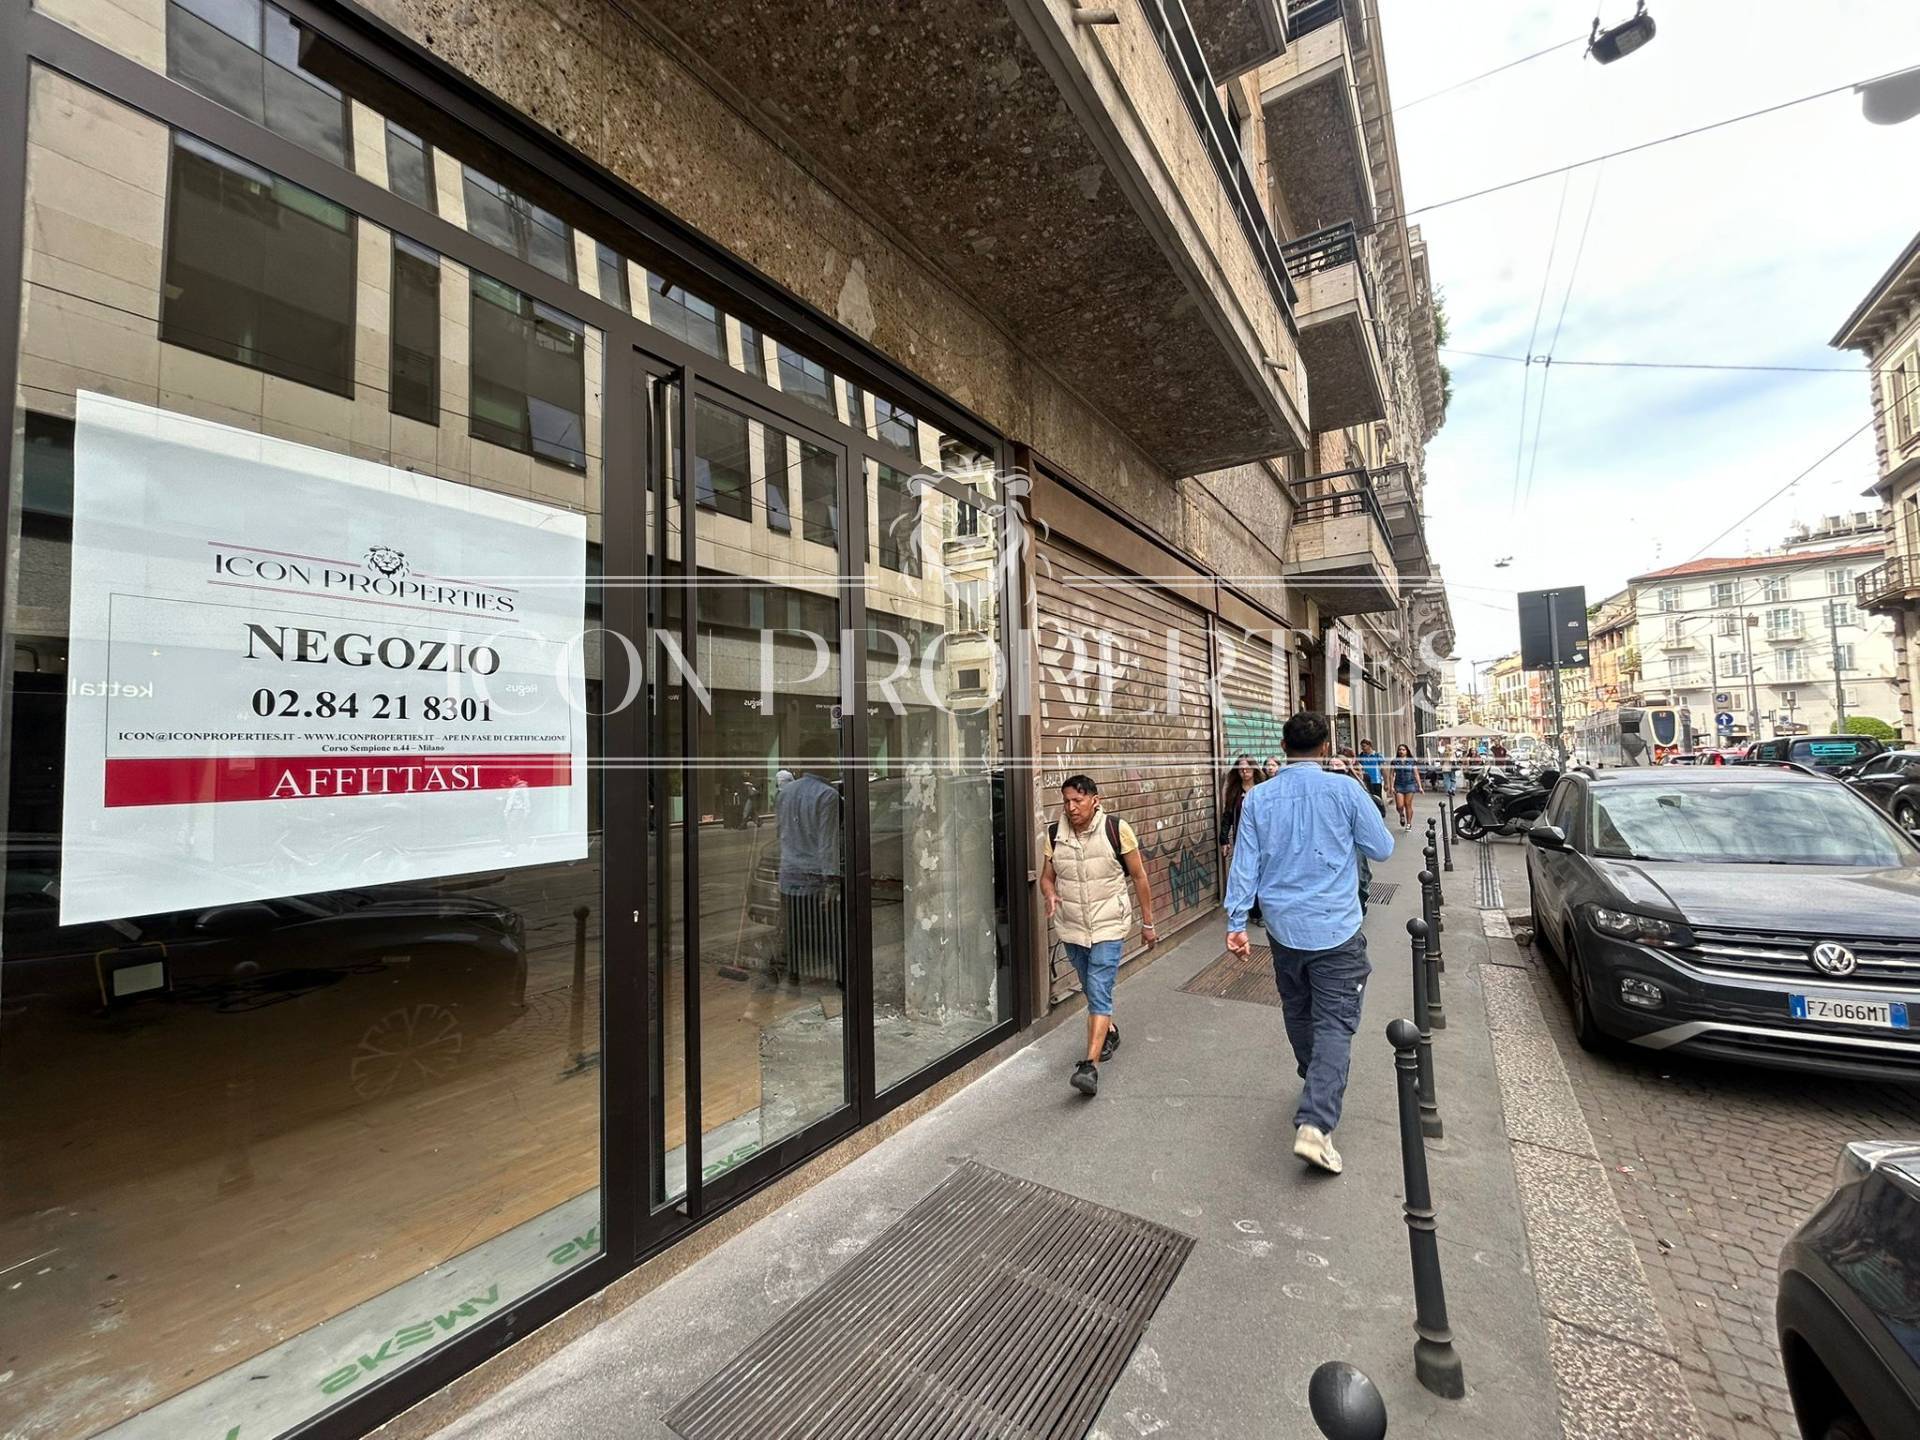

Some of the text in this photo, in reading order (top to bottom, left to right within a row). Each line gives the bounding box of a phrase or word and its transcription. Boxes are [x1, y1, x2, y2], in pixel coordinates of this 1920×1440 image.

[215, 553, 515, 613] ICON PROPERTIES
[243, 622, 501, 676] NEGOZIO
[251, 688, 494, 721] 02.84 21 8301
[118, 732, 295, 742] ICON@ICONPROPERTIES.IT
[304, 733, 434, 741] WWW.ICONPROPERTIES.IT
[321, 744, 349, 752] Corso
[350, 744, 391, 753] Sempione
[393, 744, 410, 752] n.44
[418, 744, 445, 752] Milano
[268, 764, 482, 799] AFFITTASI
